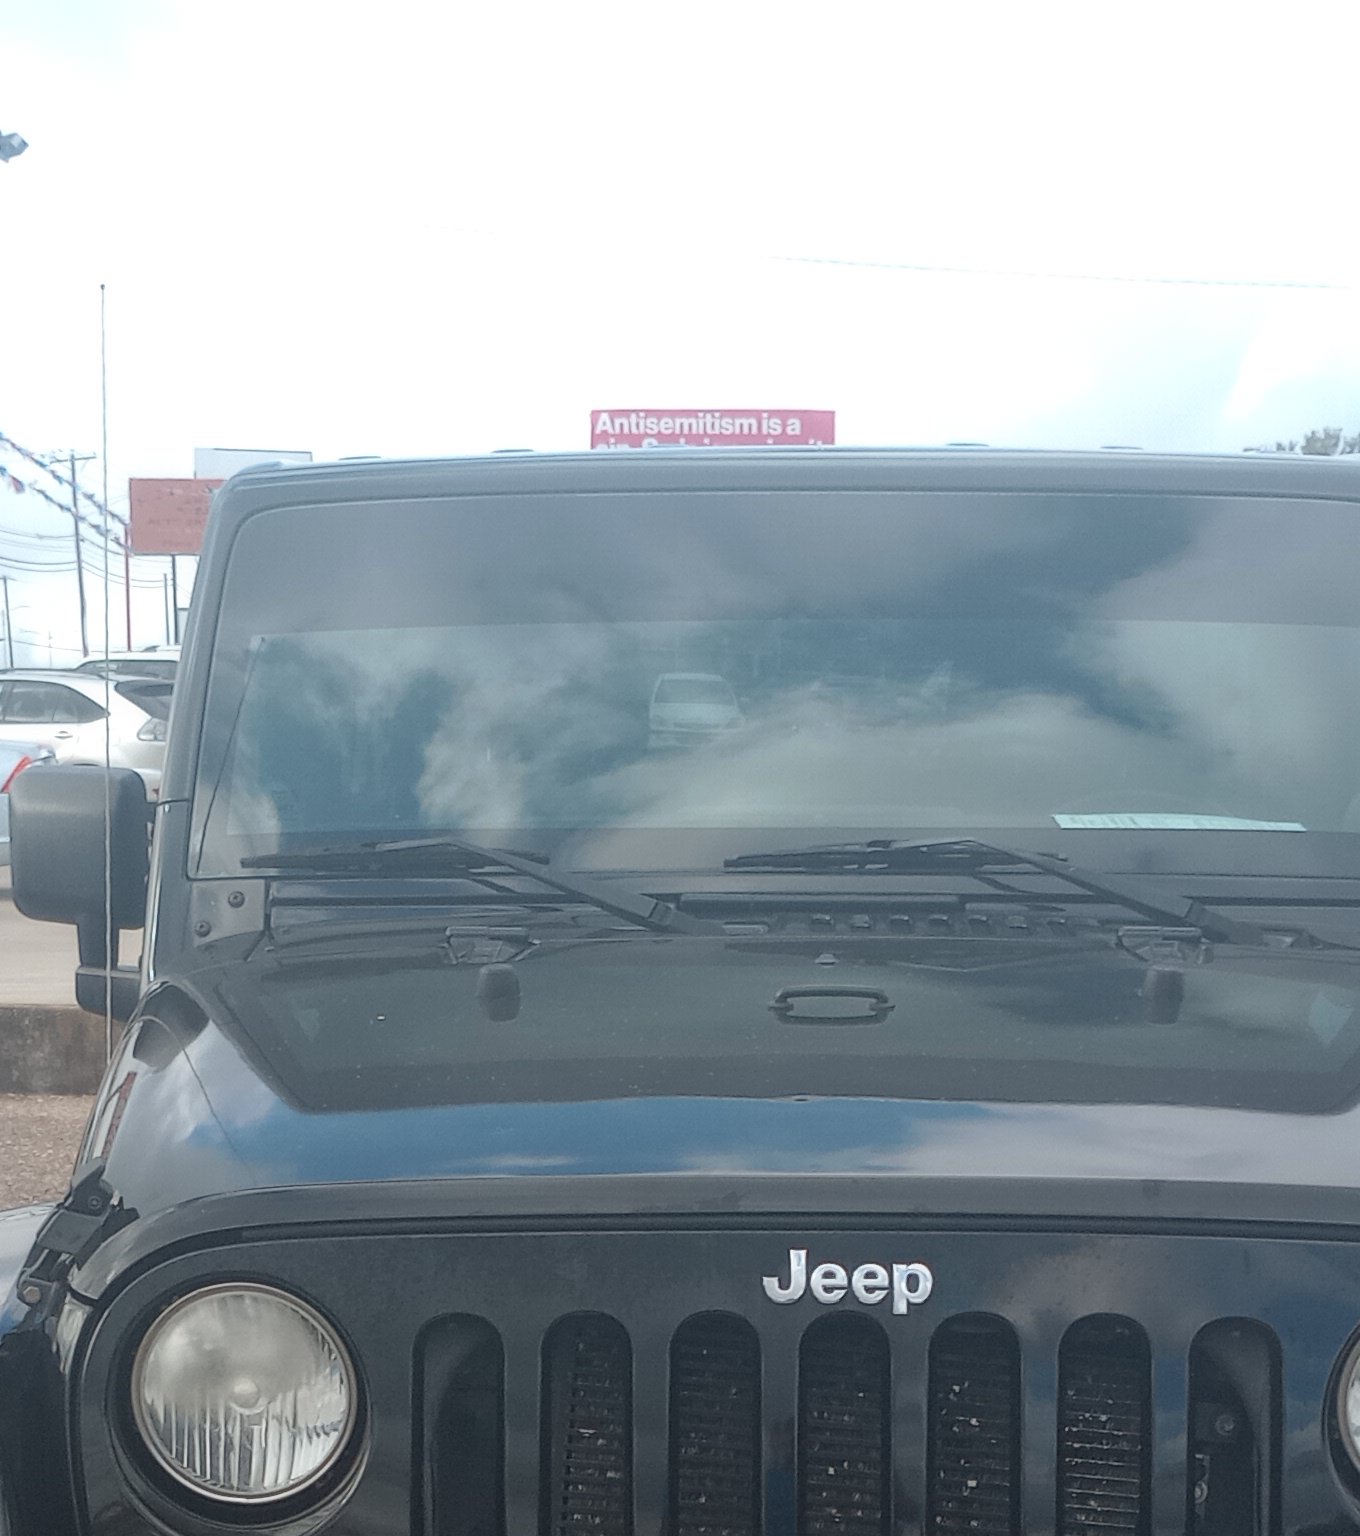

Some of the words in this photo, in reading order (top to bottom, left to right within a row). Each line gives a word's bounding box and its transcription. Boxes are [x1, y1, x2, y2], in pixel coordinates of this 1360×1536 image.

[595, 411, 758, 435] Antisemitism
[761, 412, 783, 435] is
[786, 418, 802, 435] a
[762, 1249, 933, 1315] Jeep
